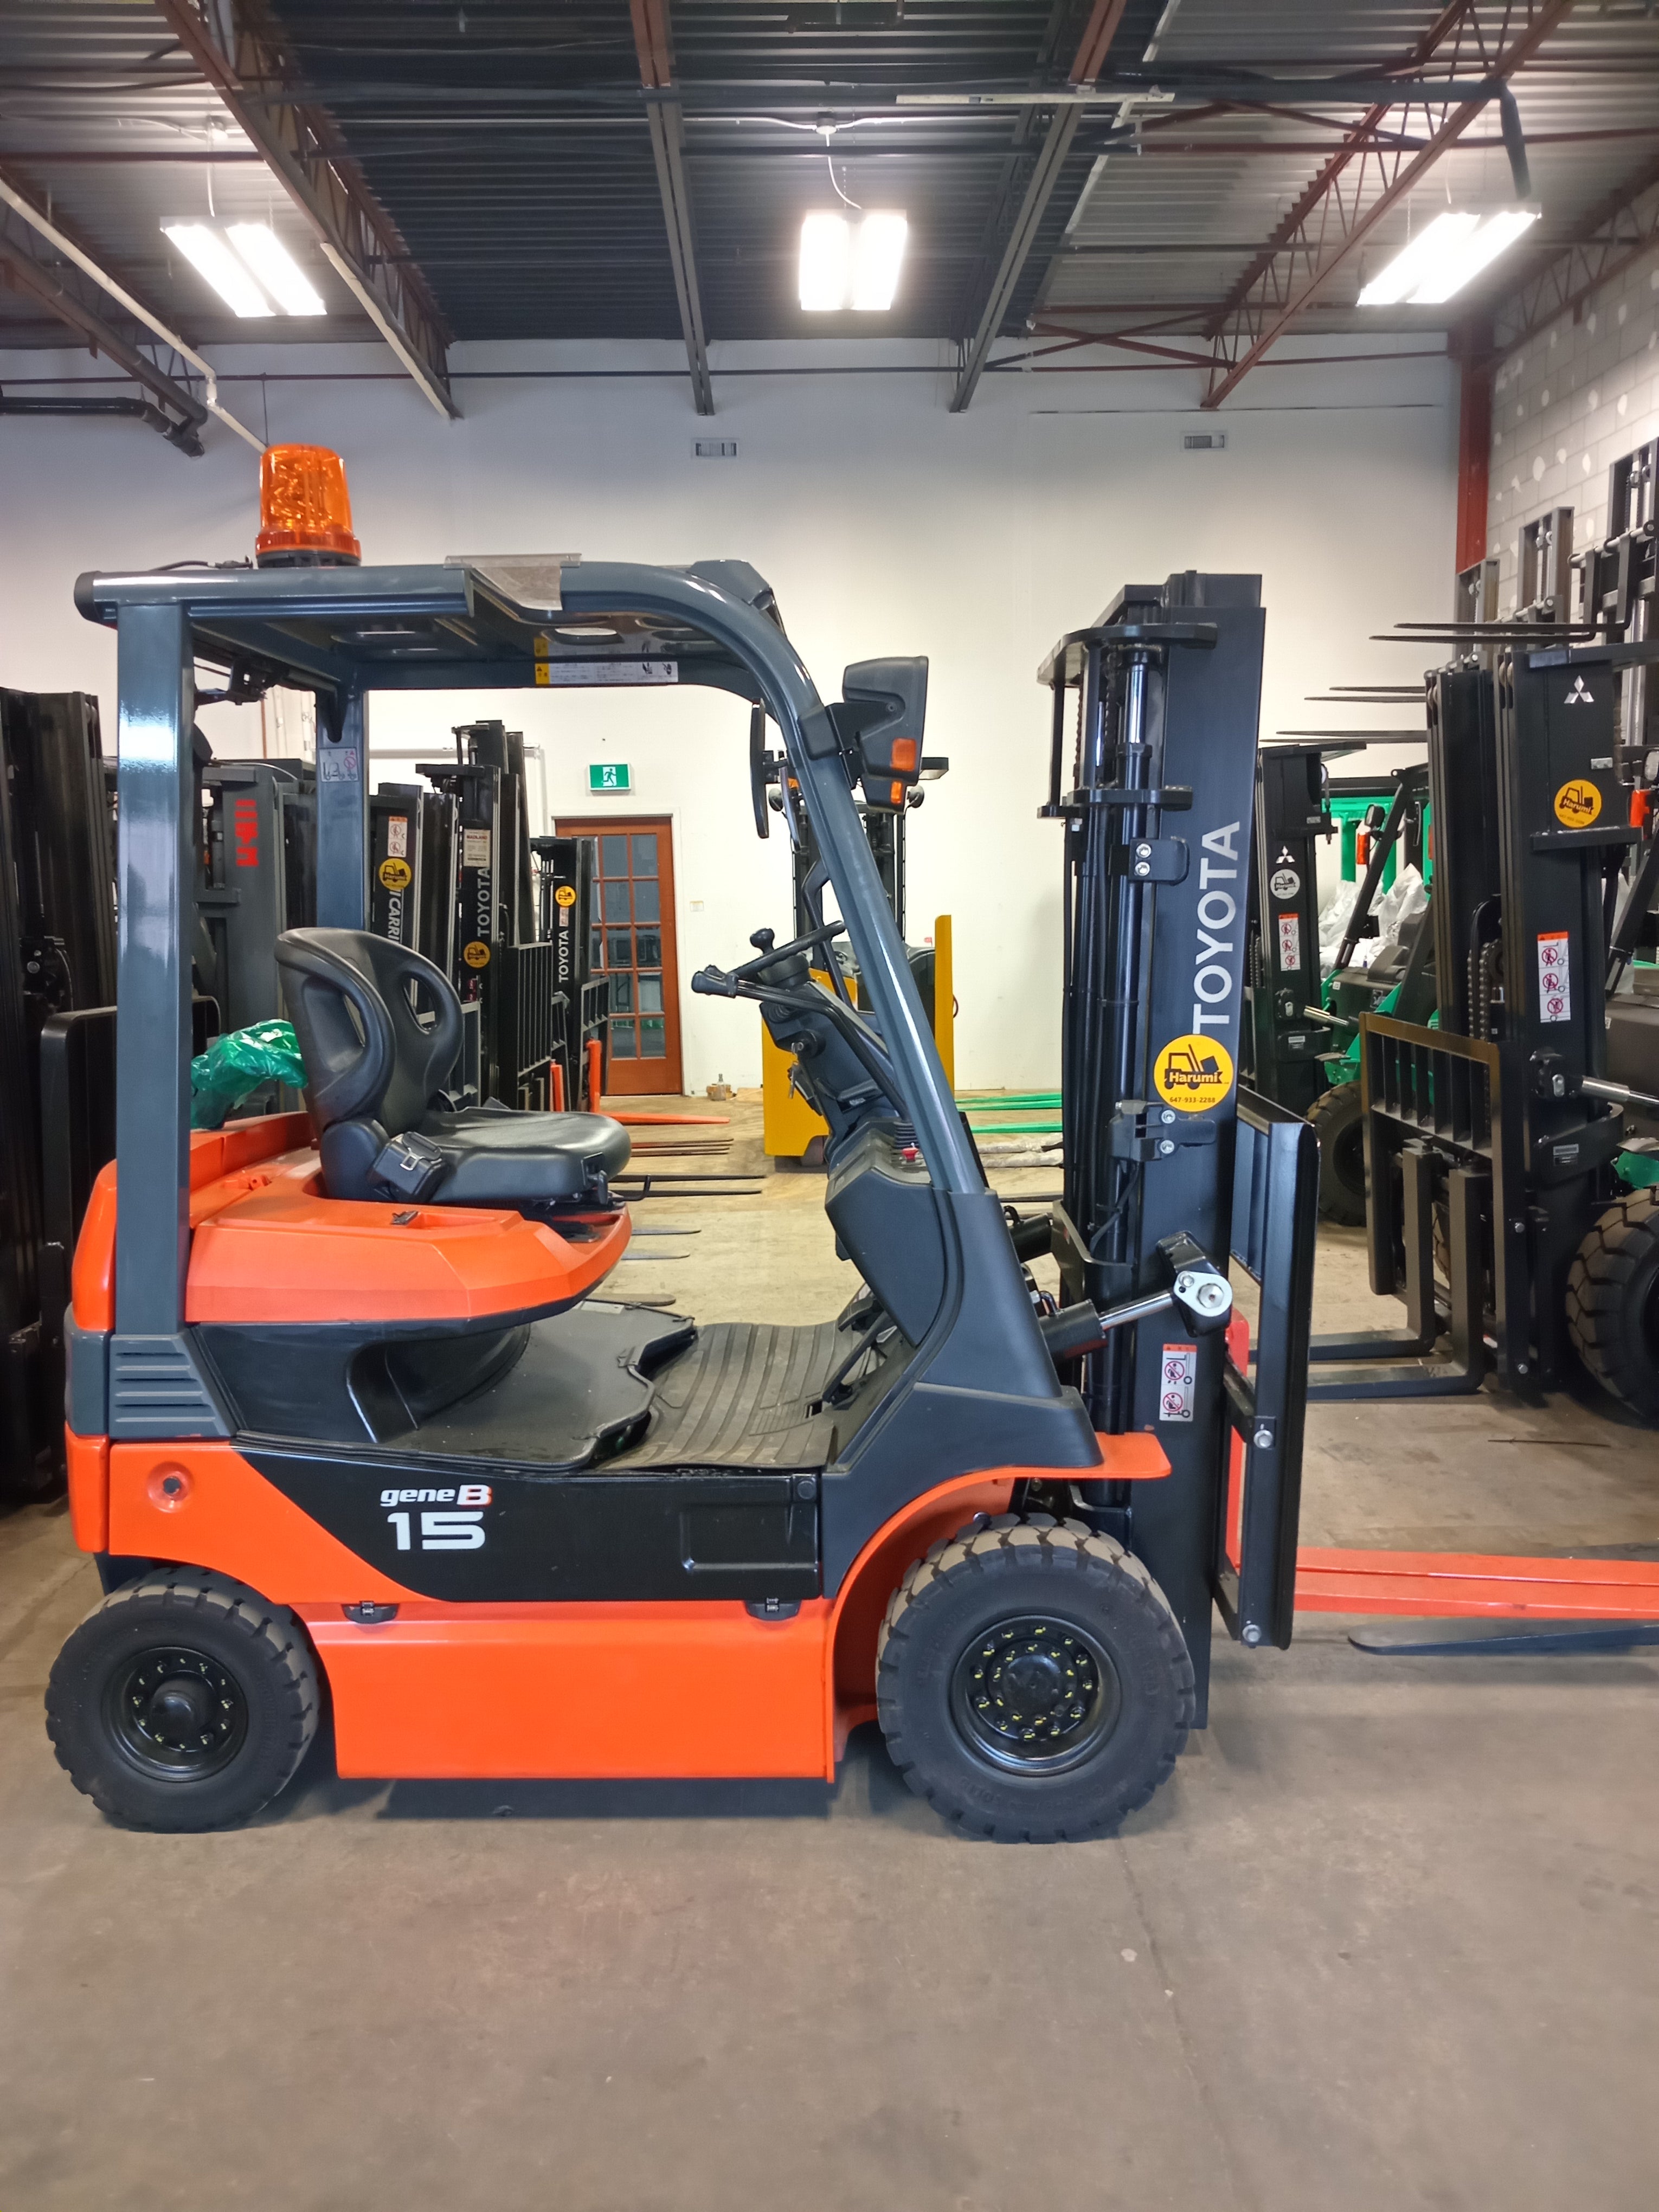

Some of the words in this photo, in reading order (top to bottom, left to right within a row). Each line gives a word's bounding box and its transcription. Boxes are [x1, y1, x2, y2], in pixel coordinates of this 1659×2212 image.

[235, 799, 259, 866] ニチユ
[1562, 798, 1592, 814] Harumi
[477, 867, 490, 937] TOYOTA
[1193, 821, 1240, 1034] TOYOTA
[558, 930, 569, 983] TOYOTA
[1169, 1071, 1218, 1083] Harumi
[387, 1511, 486, 1550] 15
